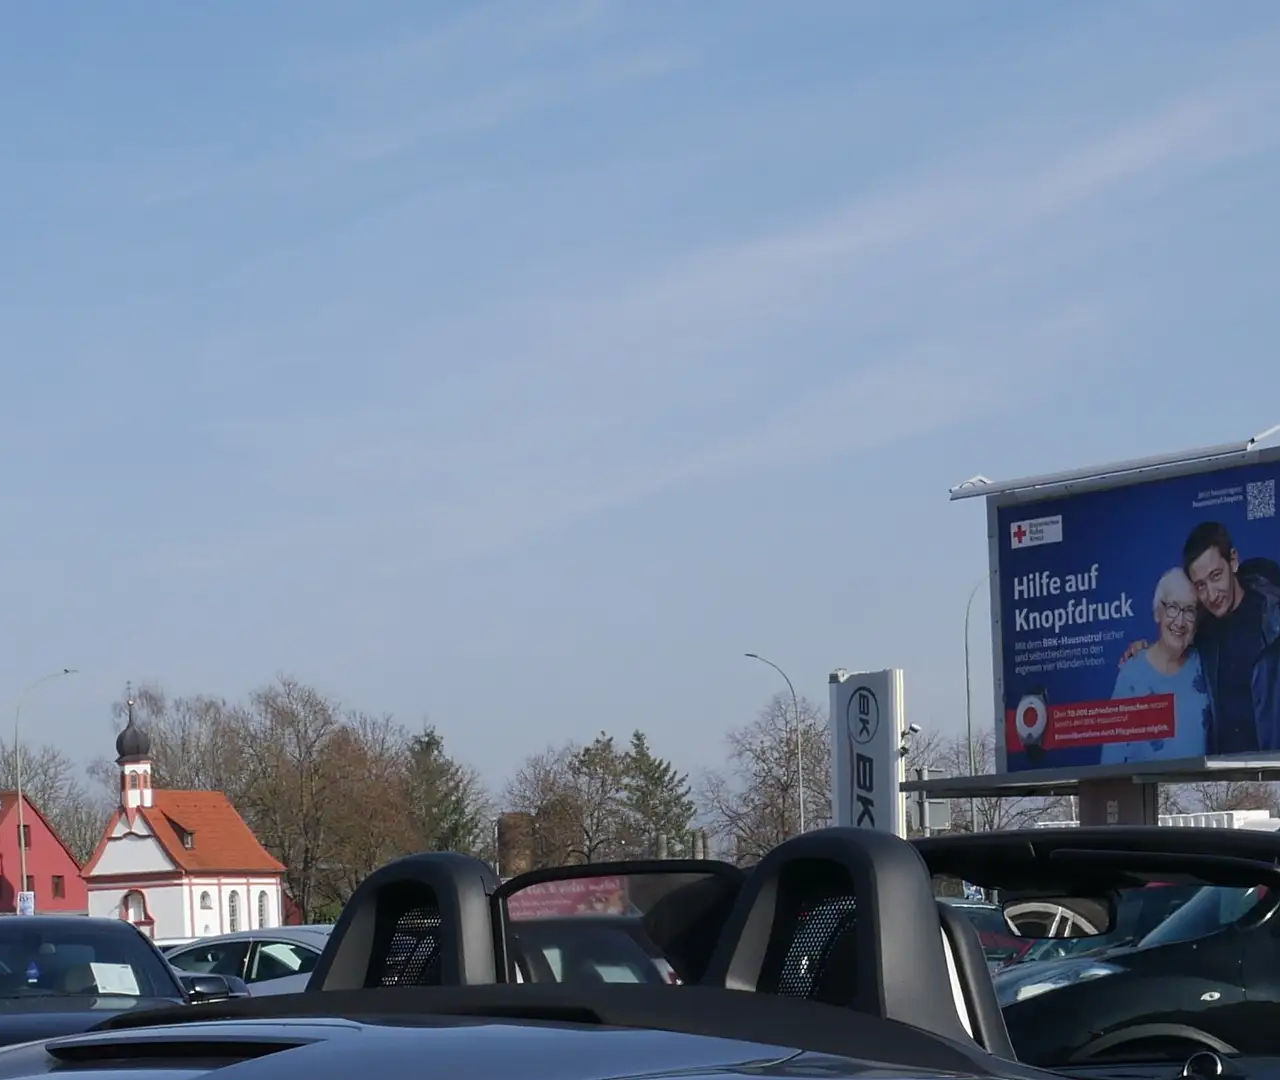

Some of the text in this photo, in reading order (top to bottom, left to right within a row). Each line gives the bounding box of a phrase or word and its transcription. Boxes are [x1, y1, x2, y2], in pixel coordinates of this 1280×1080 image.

[1013, 564, 1099, 600] Hilfe auf
[1014, 592, 1134, 634] Knopfdruck
[1015, 641, 1026, 650] Mit
[1027, 640, 1042, 649] dem
[1103, 630, 1124, 641] sicher
[1015, 652, 1028, 662] und
[1028, 647, 1081, 660] selbstbestimmt
[1090, 645, 1104, 654] den
[1015, 663, 1042, 675] eigenen
[1043, 662, 1056, 671] vier
[1056, 659, 1085, 669] Wänden
[858, 693, 871, 737] BK
[855, 753, 875, 828] BK
